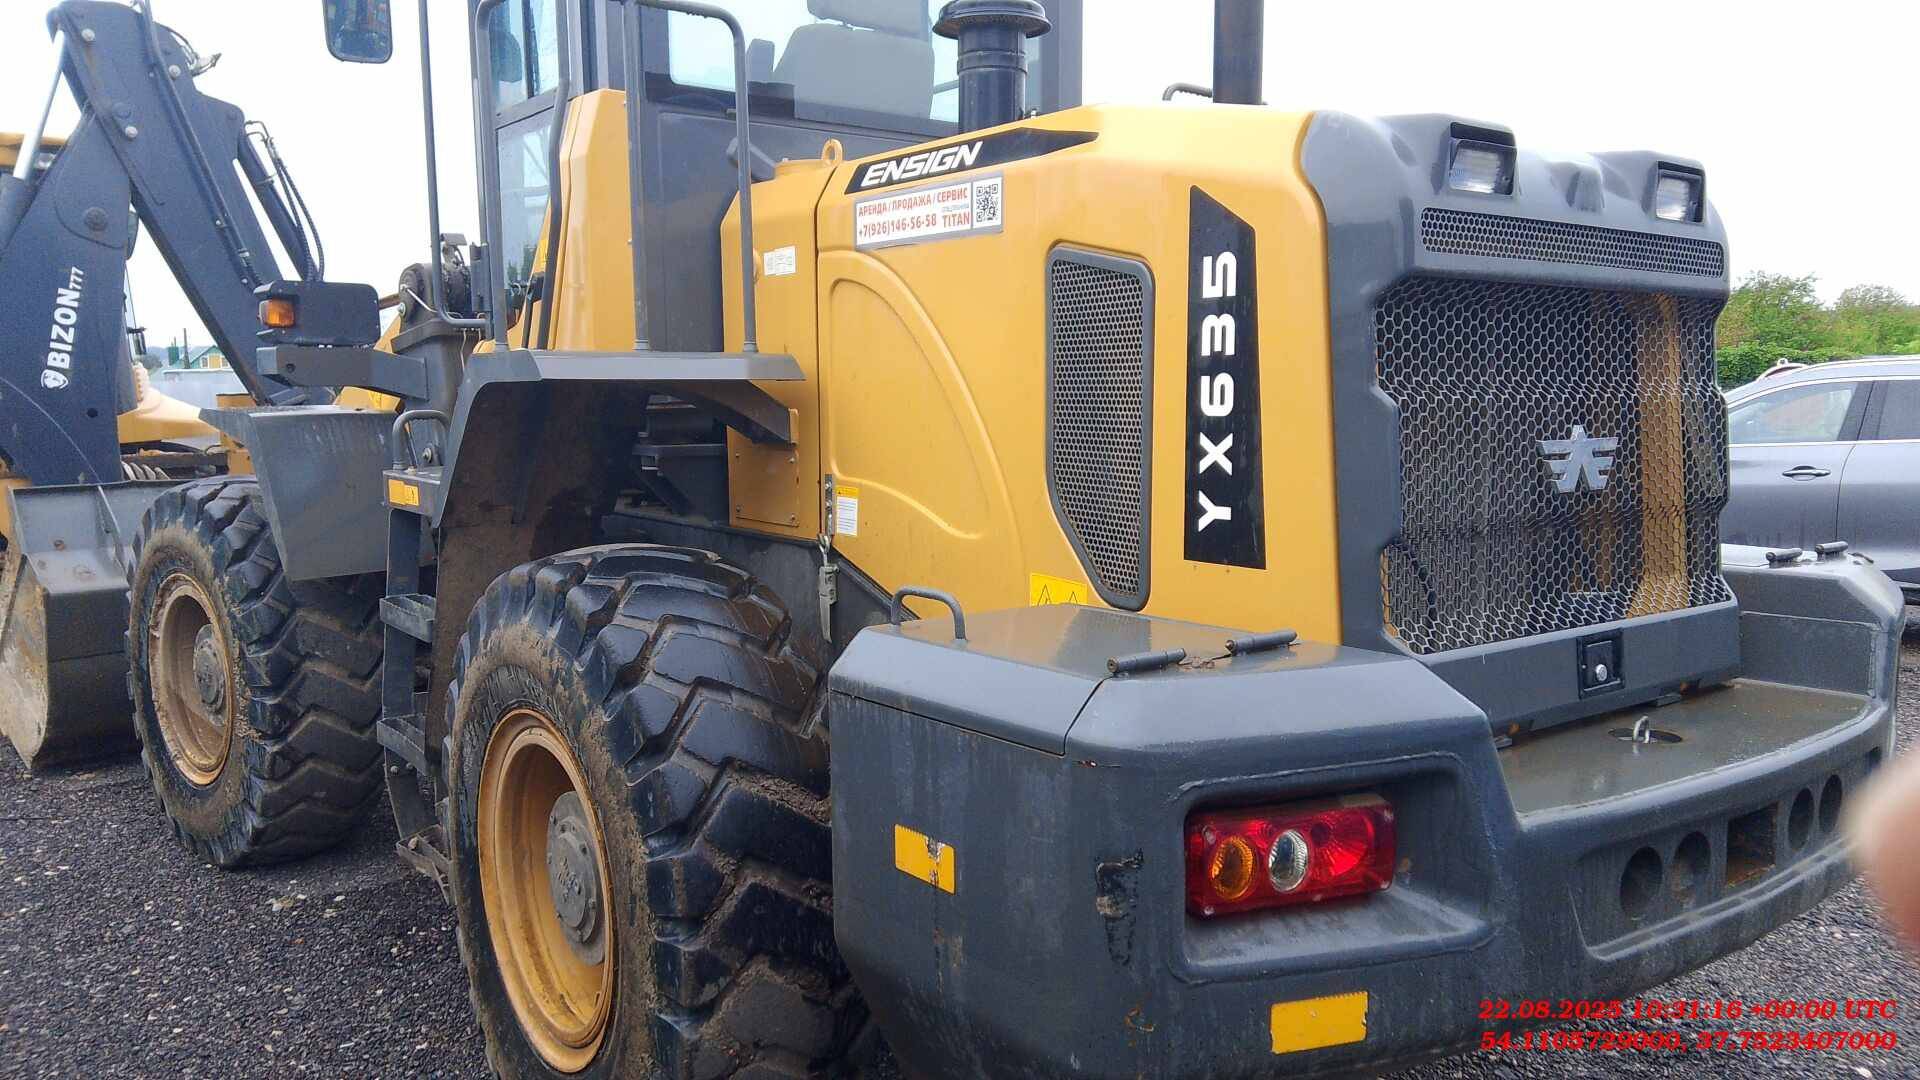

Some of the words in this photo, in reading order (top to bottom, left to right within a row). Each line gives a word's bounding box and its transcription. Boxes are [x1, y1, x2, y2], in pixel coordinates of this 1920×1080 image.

[860, 140, 984, 188] ENSIGN
[937, 186, 968, 203] СЕРВИС
[942, 210, 971, 228] TITAN
[1198, 251, 1237, 532] YX635
